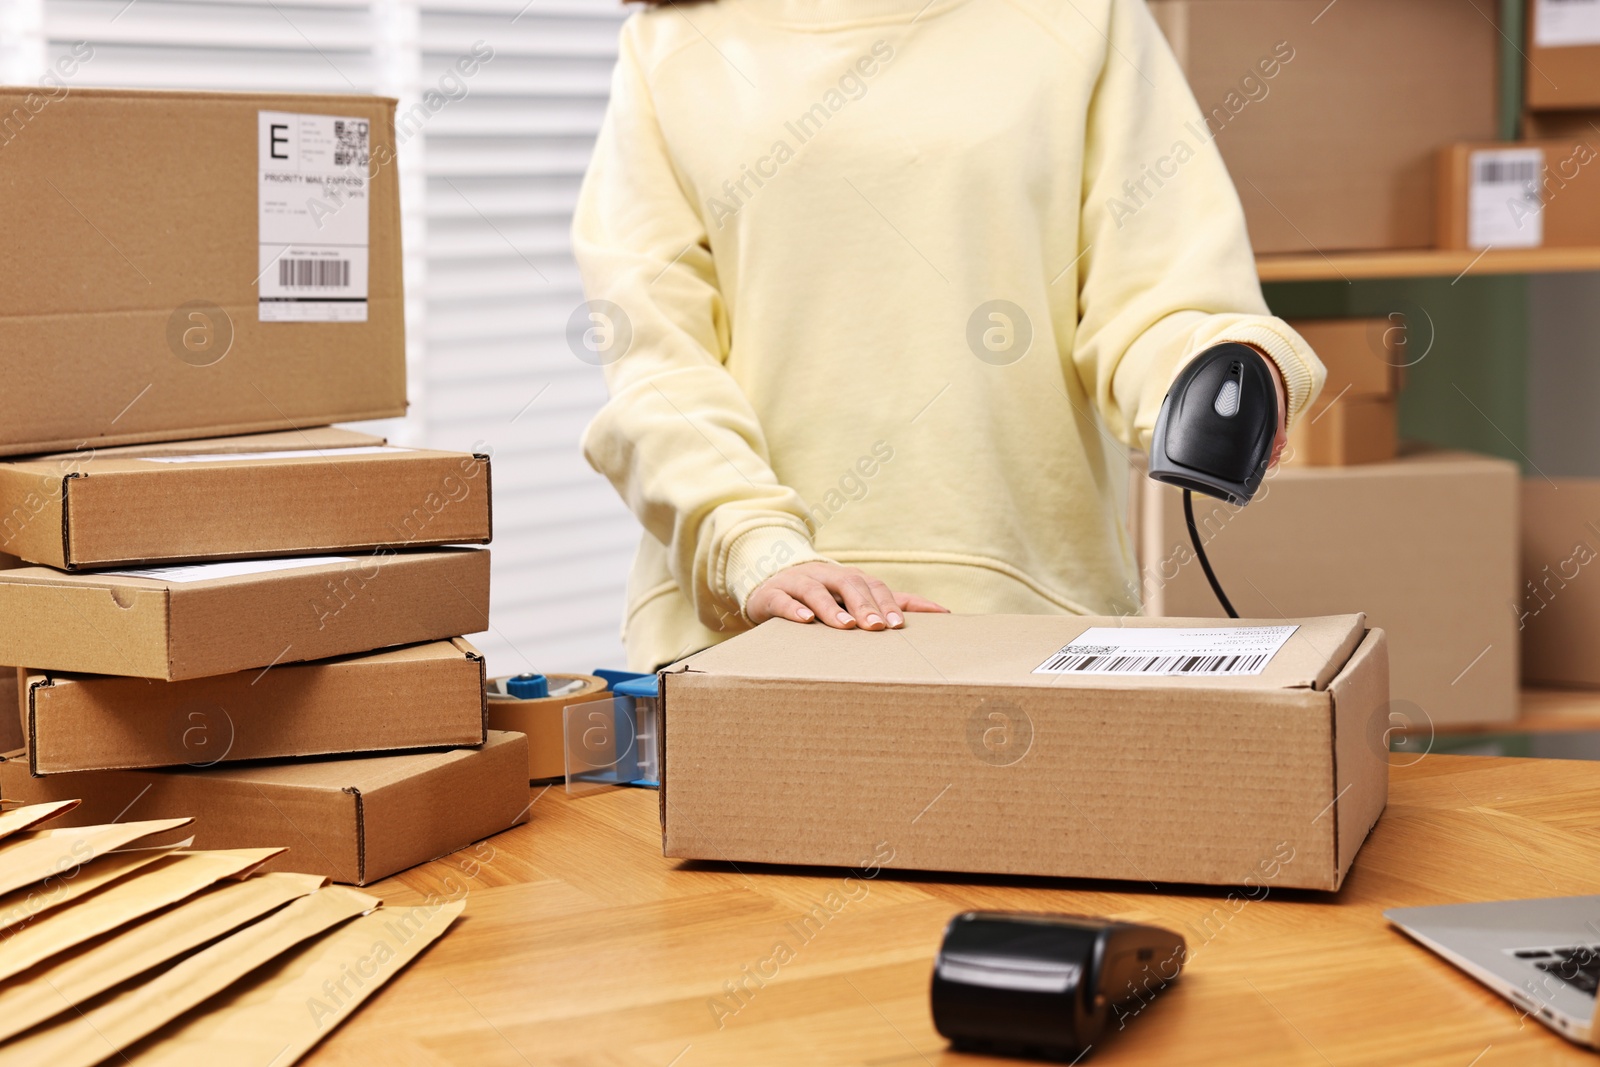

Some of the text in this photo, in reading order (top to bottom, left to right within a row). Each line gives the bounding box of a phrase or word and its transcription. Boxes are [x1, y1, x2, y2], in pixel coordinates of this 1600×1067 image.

[270, 123, 289, 159] E
[265, 173, 364, 186] PRIORITY MAIL EXPRESS
